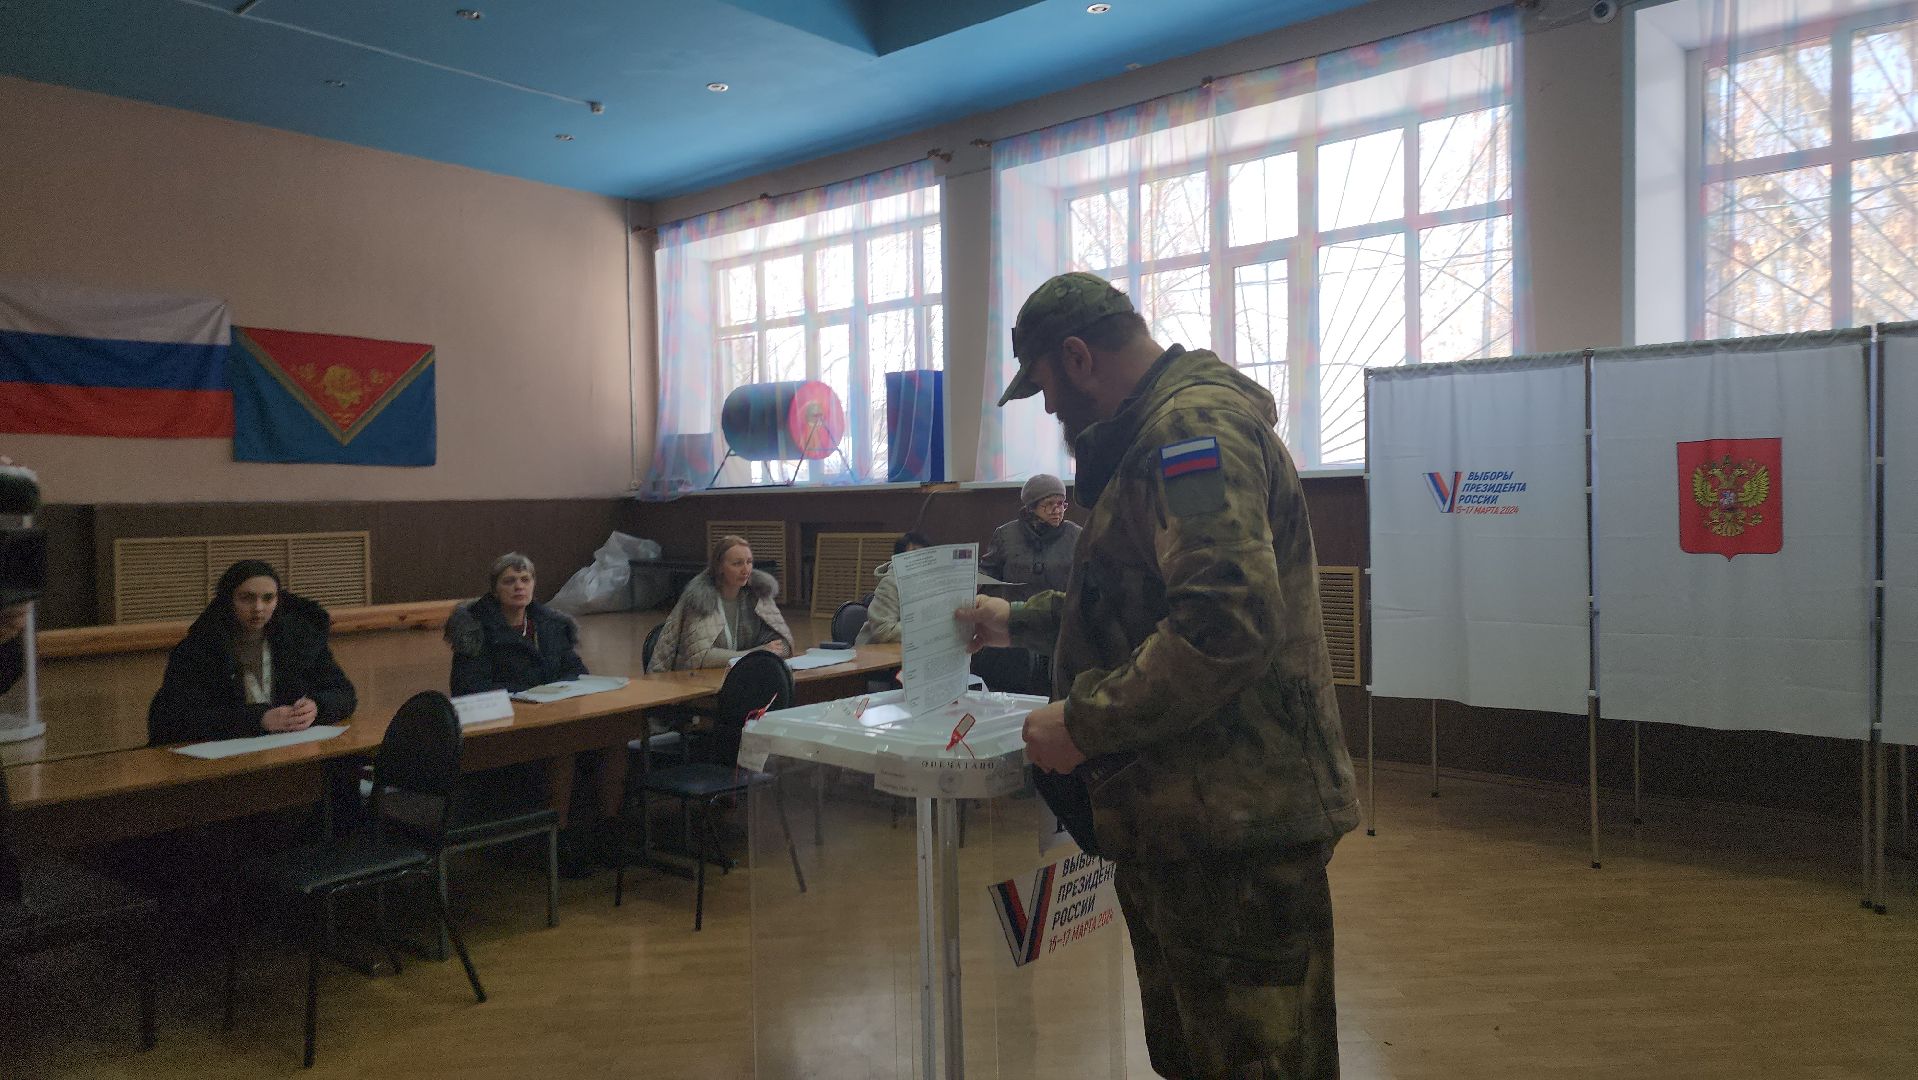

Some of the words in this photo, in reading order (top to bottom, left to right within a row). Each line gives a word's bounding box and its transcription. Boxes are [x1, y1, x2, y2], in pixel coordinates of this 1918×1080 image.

[1462, 482, 1527, 493] ПРЕЗИДЕНТА
[1467, 471, 1514, 481] ВЫБОРЫ
[1458, 494, 1499, 504] РОССИИ
[1062, 852, 1096, 877] ВЫБО
[1057, 863, 1116, 904] ПРЕЗИДЕНТ
[1052, 893, 1096, 931] РОССИИ
[1071, 916, 1097, 941] МАРТА
